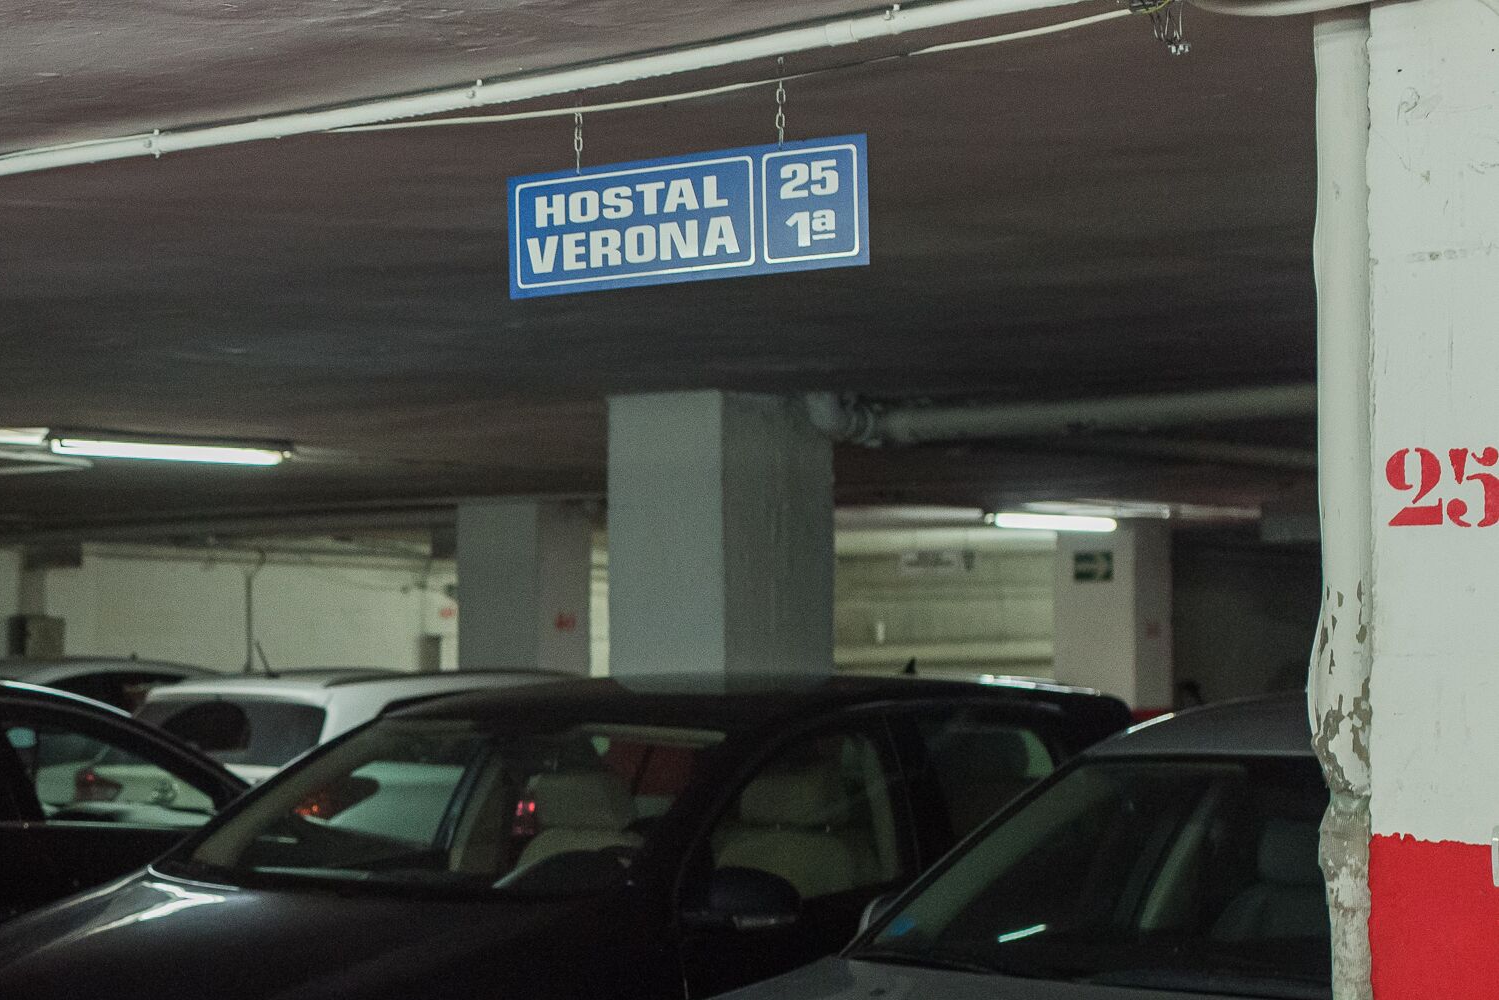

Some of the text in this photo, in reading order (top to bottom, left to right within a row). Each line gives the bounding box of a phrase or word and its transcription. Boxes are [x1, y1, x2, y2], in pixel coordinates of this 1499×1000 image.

[535, 175, 729, 228] HOSTAL
[779, 159, 839, 200] 25
[526, 216, 740, 274] VERONA
[785, 209, 836, 247] 1ª
[1385, 446, 1499, 528] 25
